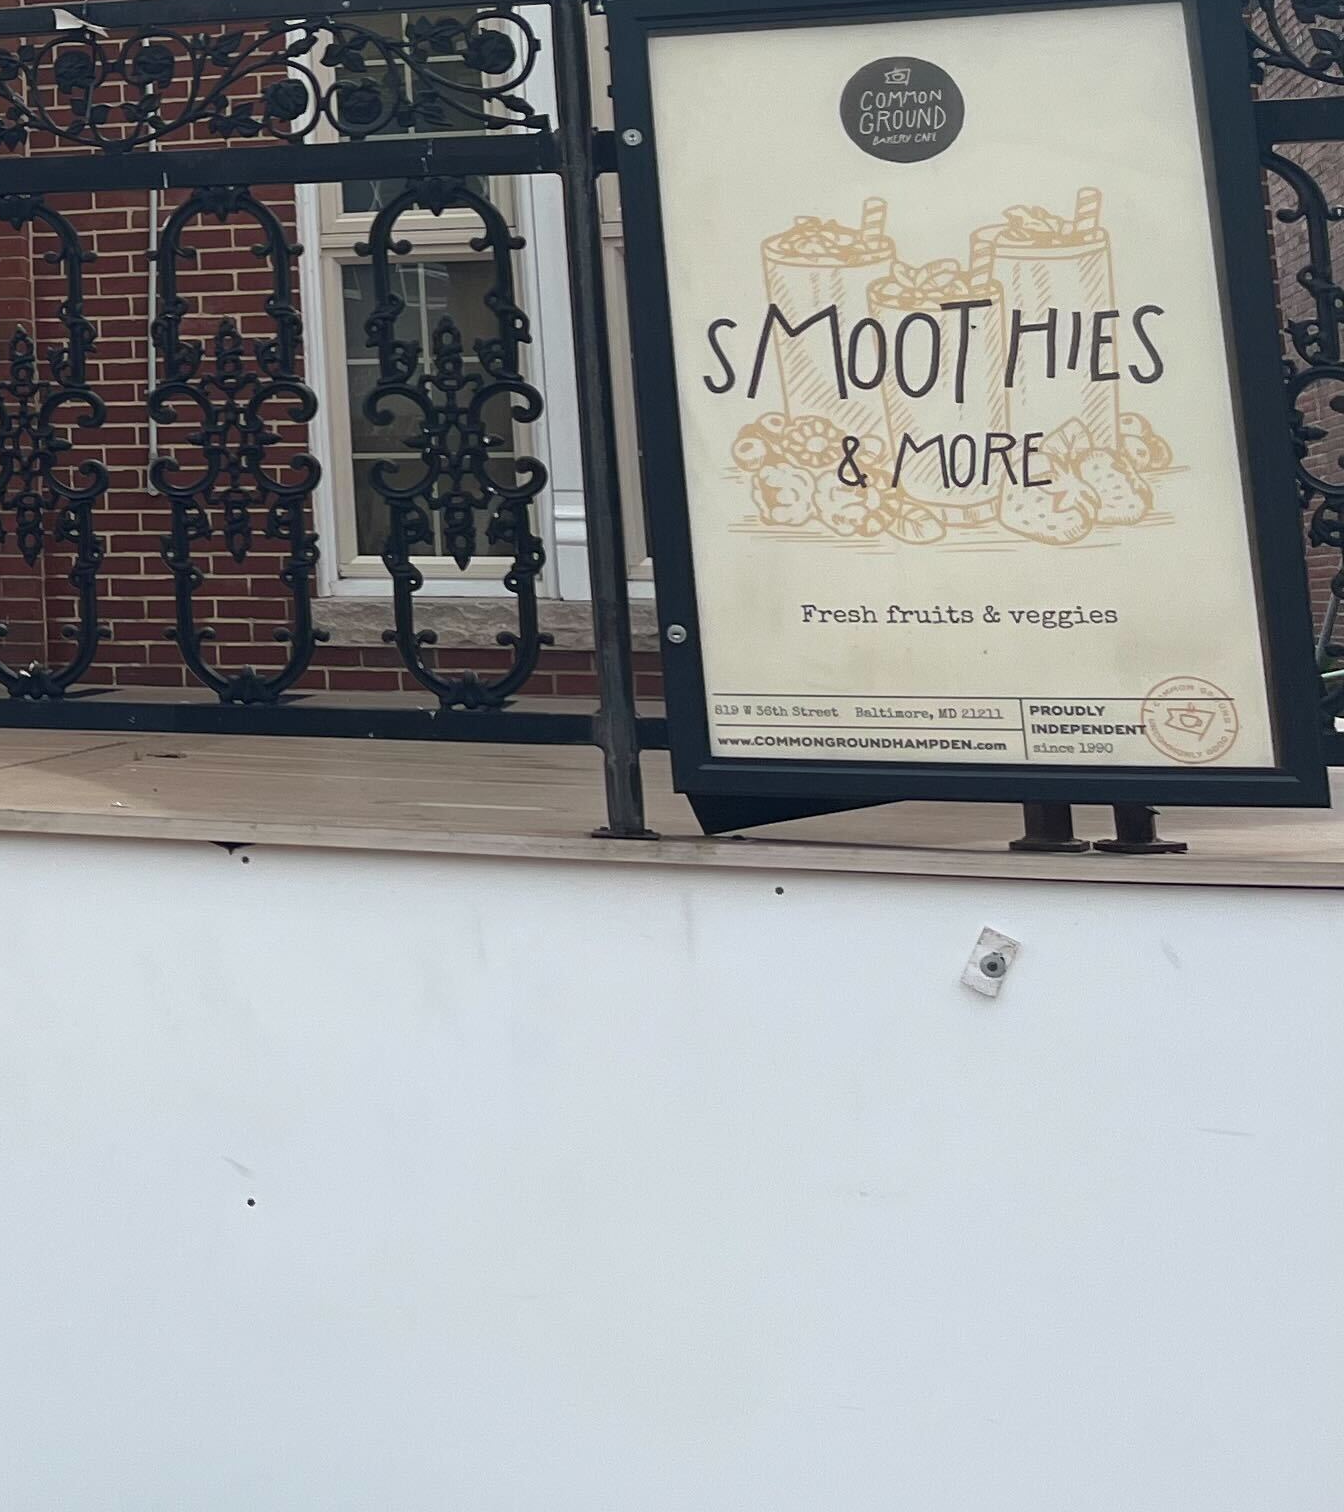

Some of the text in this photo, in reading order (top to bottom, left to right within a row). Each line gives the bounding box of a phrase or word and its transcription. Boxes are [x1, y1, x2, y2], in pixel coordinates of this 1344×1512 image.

[861, 90, 942, 111] COMMON
[860, 106, 946, 134] GROUND
[702, 299, 1166, 404] SMOOTHIES
[838, 431, 1054, 492] & MORE
[801, 605, 1117, 628] Fresh fruits & veggies
[792, 706, 839, 717] Street
[855, 707, 933, 720] Baltimore,
[939, 708, 957, 718] MD
[962, 708, 1003, 719] 21211
[1030, 706, 1105, 716] PROUDLY
[1032, 724, 1146, 735] INDEPENDENT
[718, 736, 1006, 750] www.COMMONGROUNDHAMPDEN.com
[1034, 743, 1113, 753] since 1990
